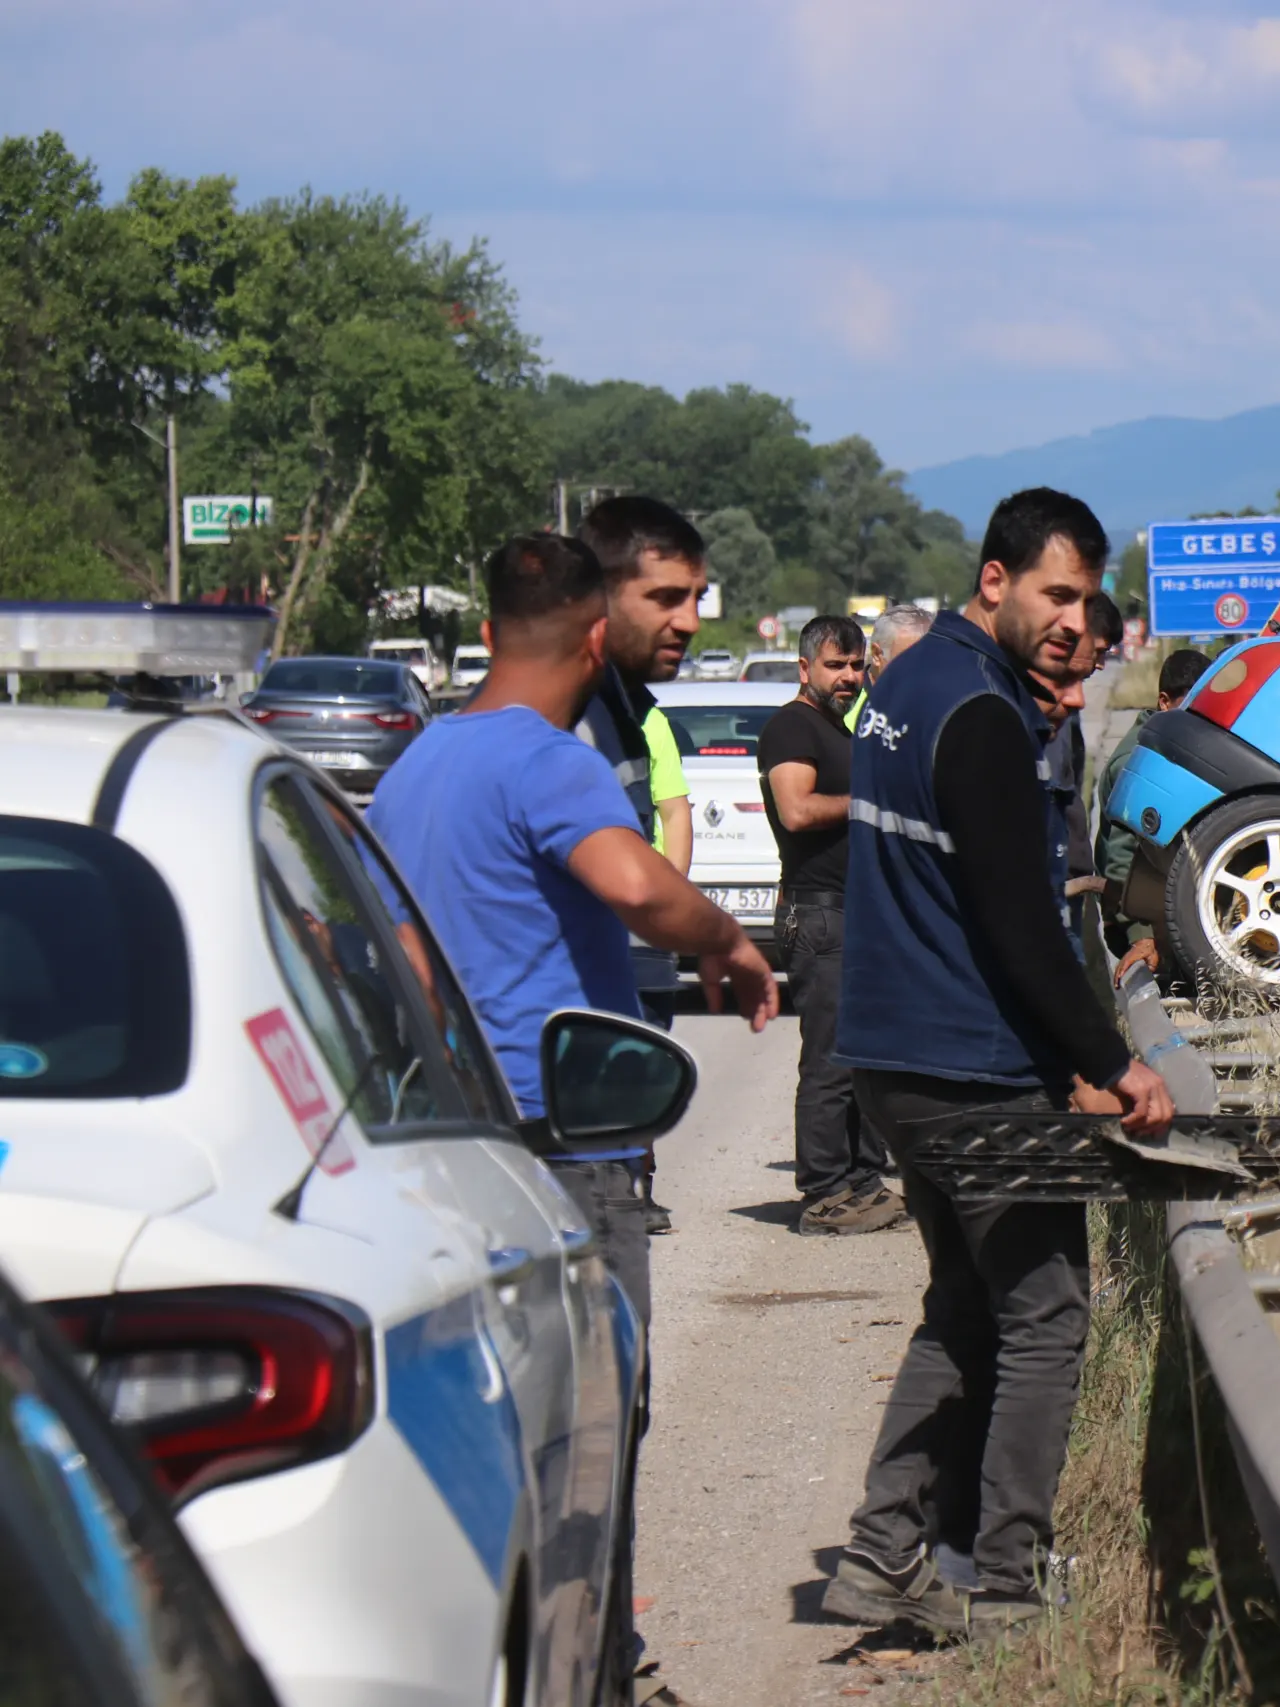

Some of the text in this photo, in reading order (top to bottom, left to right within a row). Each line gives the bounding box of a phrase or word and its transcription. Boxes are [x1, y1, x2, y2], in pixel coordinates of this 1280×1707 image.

[1182, 532, 1277, 555] GEBEŞ
[1221, 603, 1243, 620] 80
[694, 832, 746, 840] EGANE
[739, 889, 770, 909] 537
